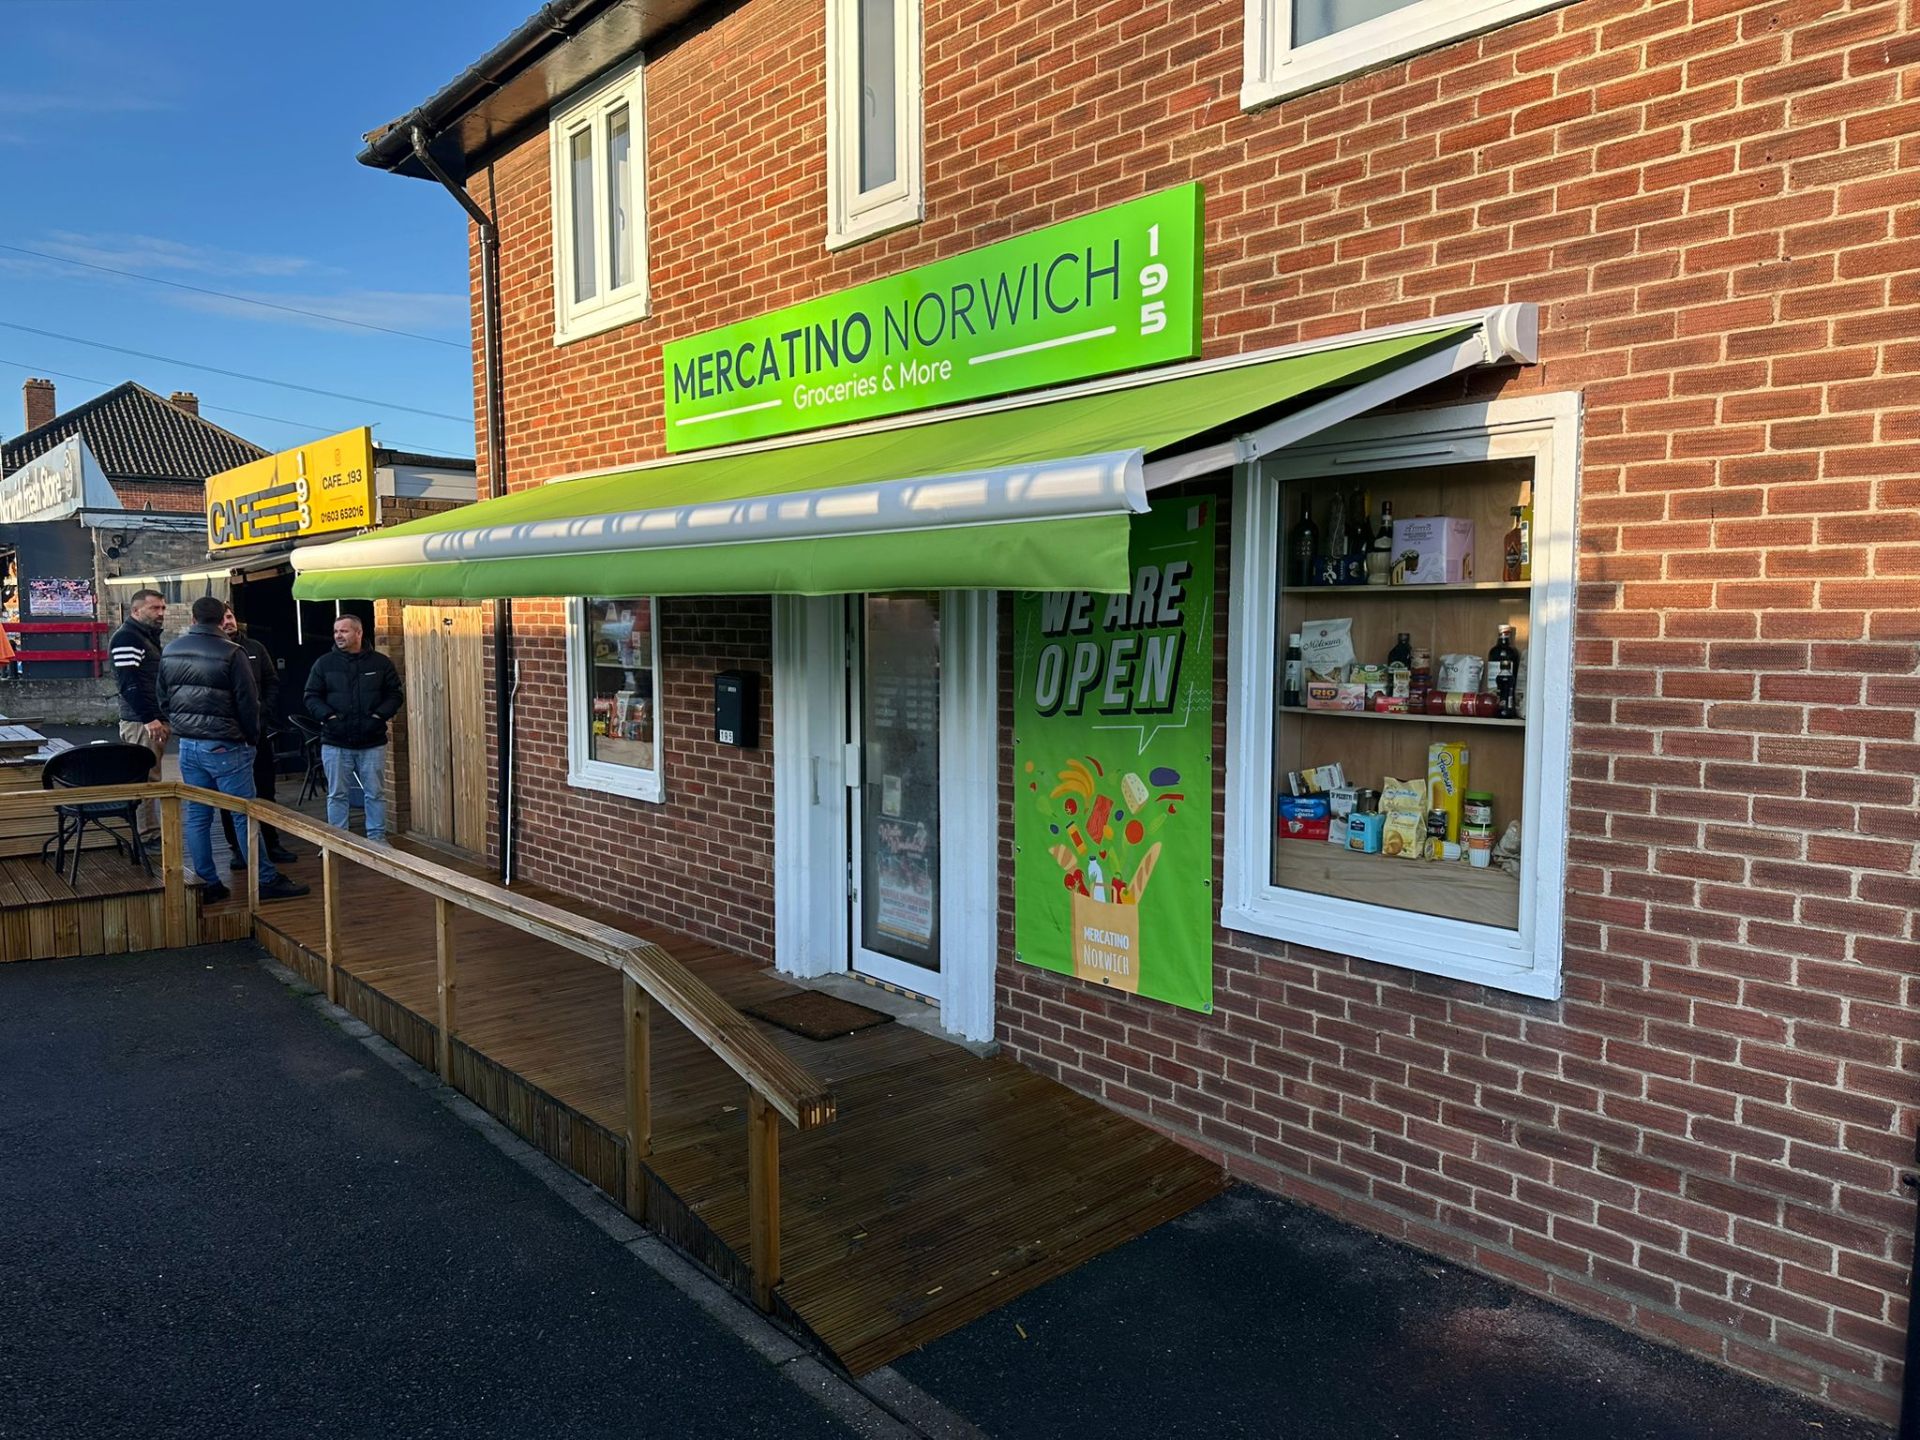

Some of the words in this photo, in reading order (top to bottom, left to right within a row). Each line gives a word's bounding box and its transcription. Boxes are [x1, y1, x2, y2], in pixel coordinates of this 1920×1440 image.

[673, 311, 872, 404] MERCATINO
[884, 239, 1120, 356] NORWICH
[793, 372, 878, 410] Groceries
[881, 364, 894, 390] &
[899, 357, 953, 386] More
[41, 466, 62, 511] Store
[321, 510, 339, 523] 01603
[340, 505, 364, 520] 652016
[1041, 590, 1092, 633] WE
[1102, 560, 1190, 628] ARE
[1035, 634, 1180, 711] OPEN
[1312, 688, 1335, 696] RIO
[1083, 926, 1130, 951] MERCATINO
[1083, 944, 1130, 976] NORWICH
